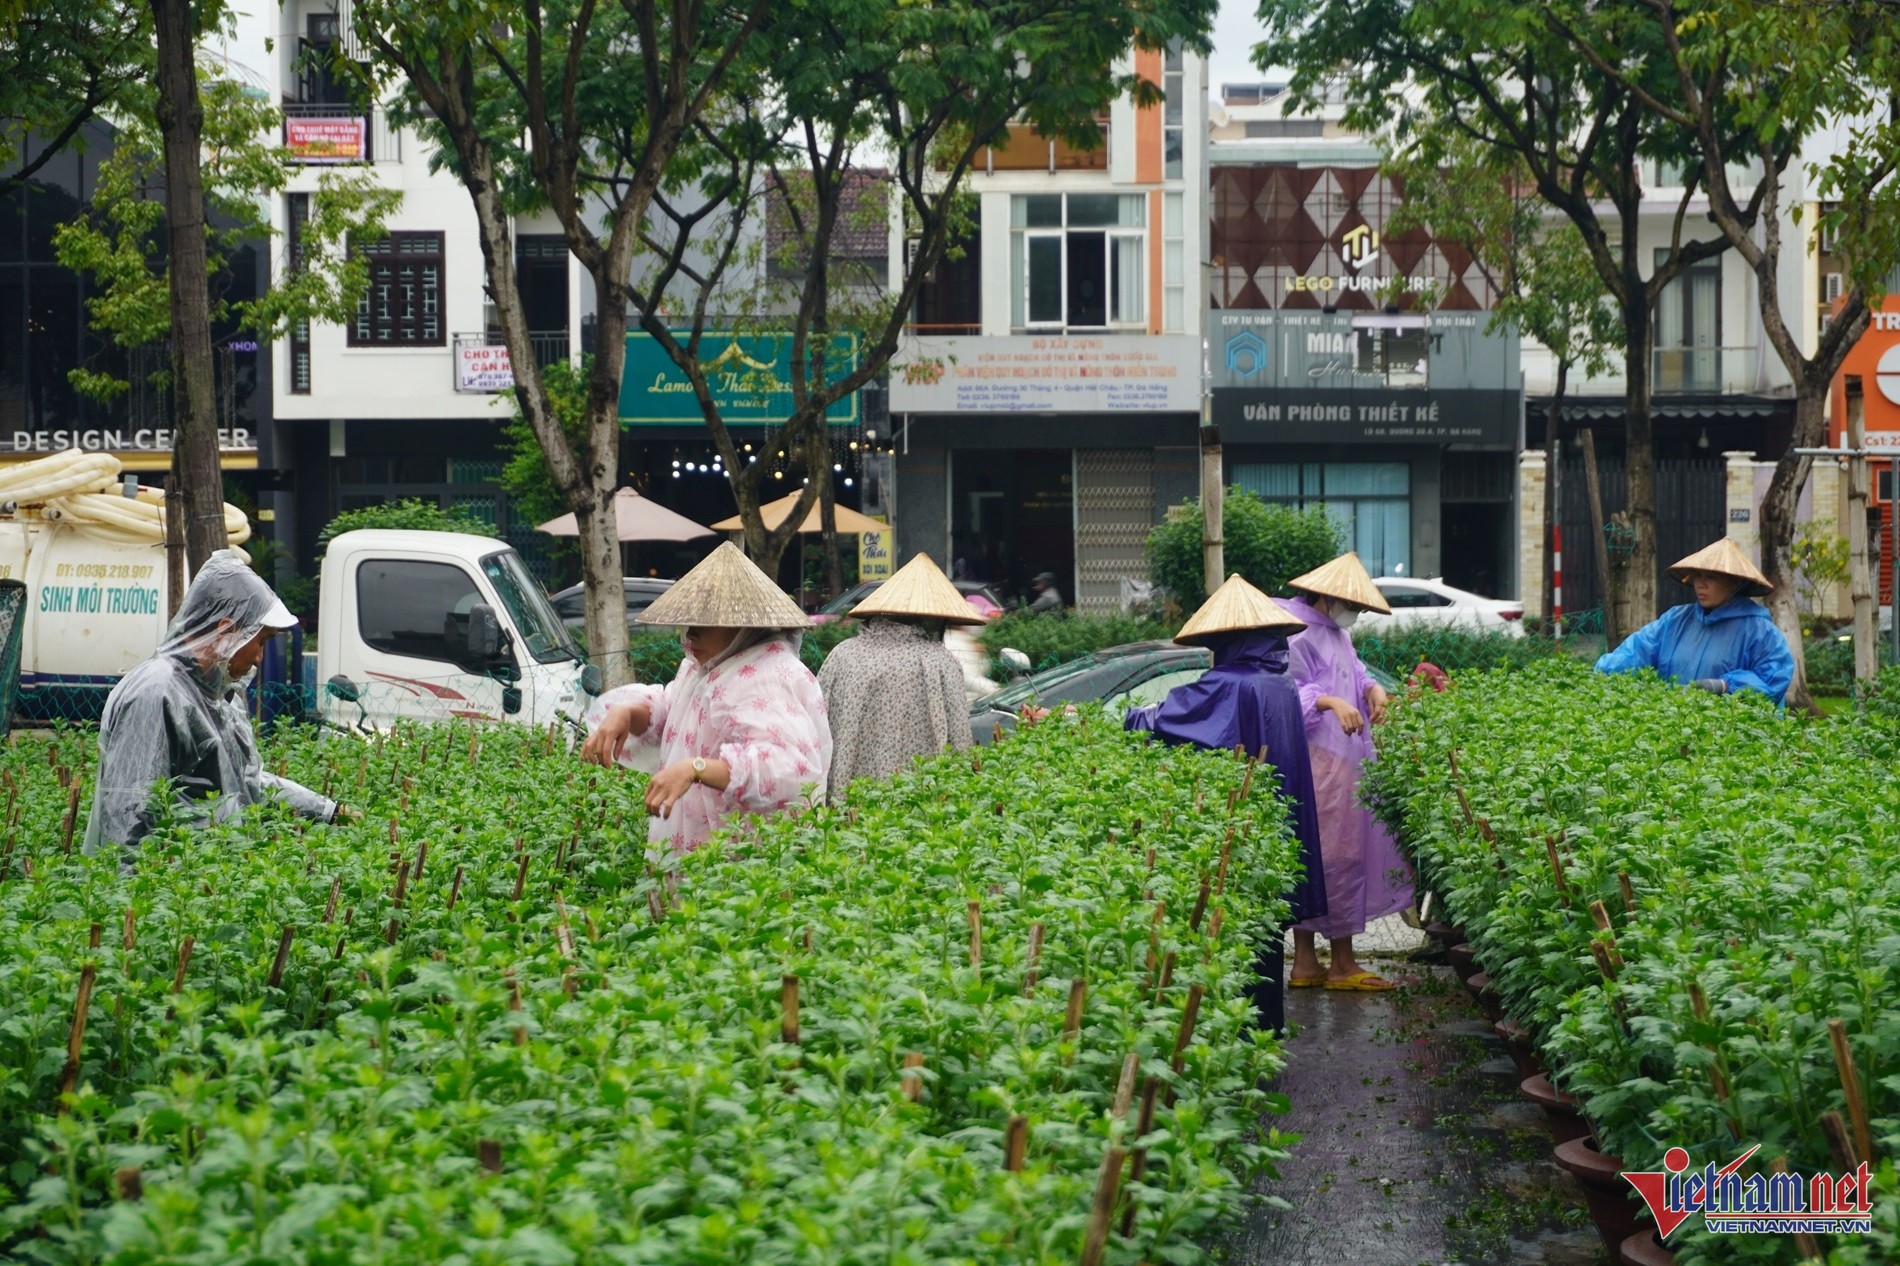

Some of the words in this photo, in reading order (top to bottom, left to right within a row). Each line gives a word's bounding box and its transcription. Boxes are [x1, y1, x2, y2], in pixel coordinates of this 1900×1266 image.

[1285, 276, 1334, 292] LEGO
[1338, 276, 1435, 293] FURNIURE
[1222, 316, 1239, 326] CTY
[1032, 339, 1046, 350] BỘ
[464, 350, 490, 359] CHO
[494, 349, 510, 358] TH
[1243, 402, 1281, 421] VĂN
[1287, 402, 1351, 421] PHÒNG
[1358, 400, 1410, 422] THIẾT
[1415, 400, 1439, 422] KẾ
[13, 429, 122, 451] DESIGN
[135, 428, 249, 449] CEER
[40, 586, 74, 612] SINH
[76, 582, 103, 613] MÔI
[106, 582, 159, 614] TRƯỜNG
